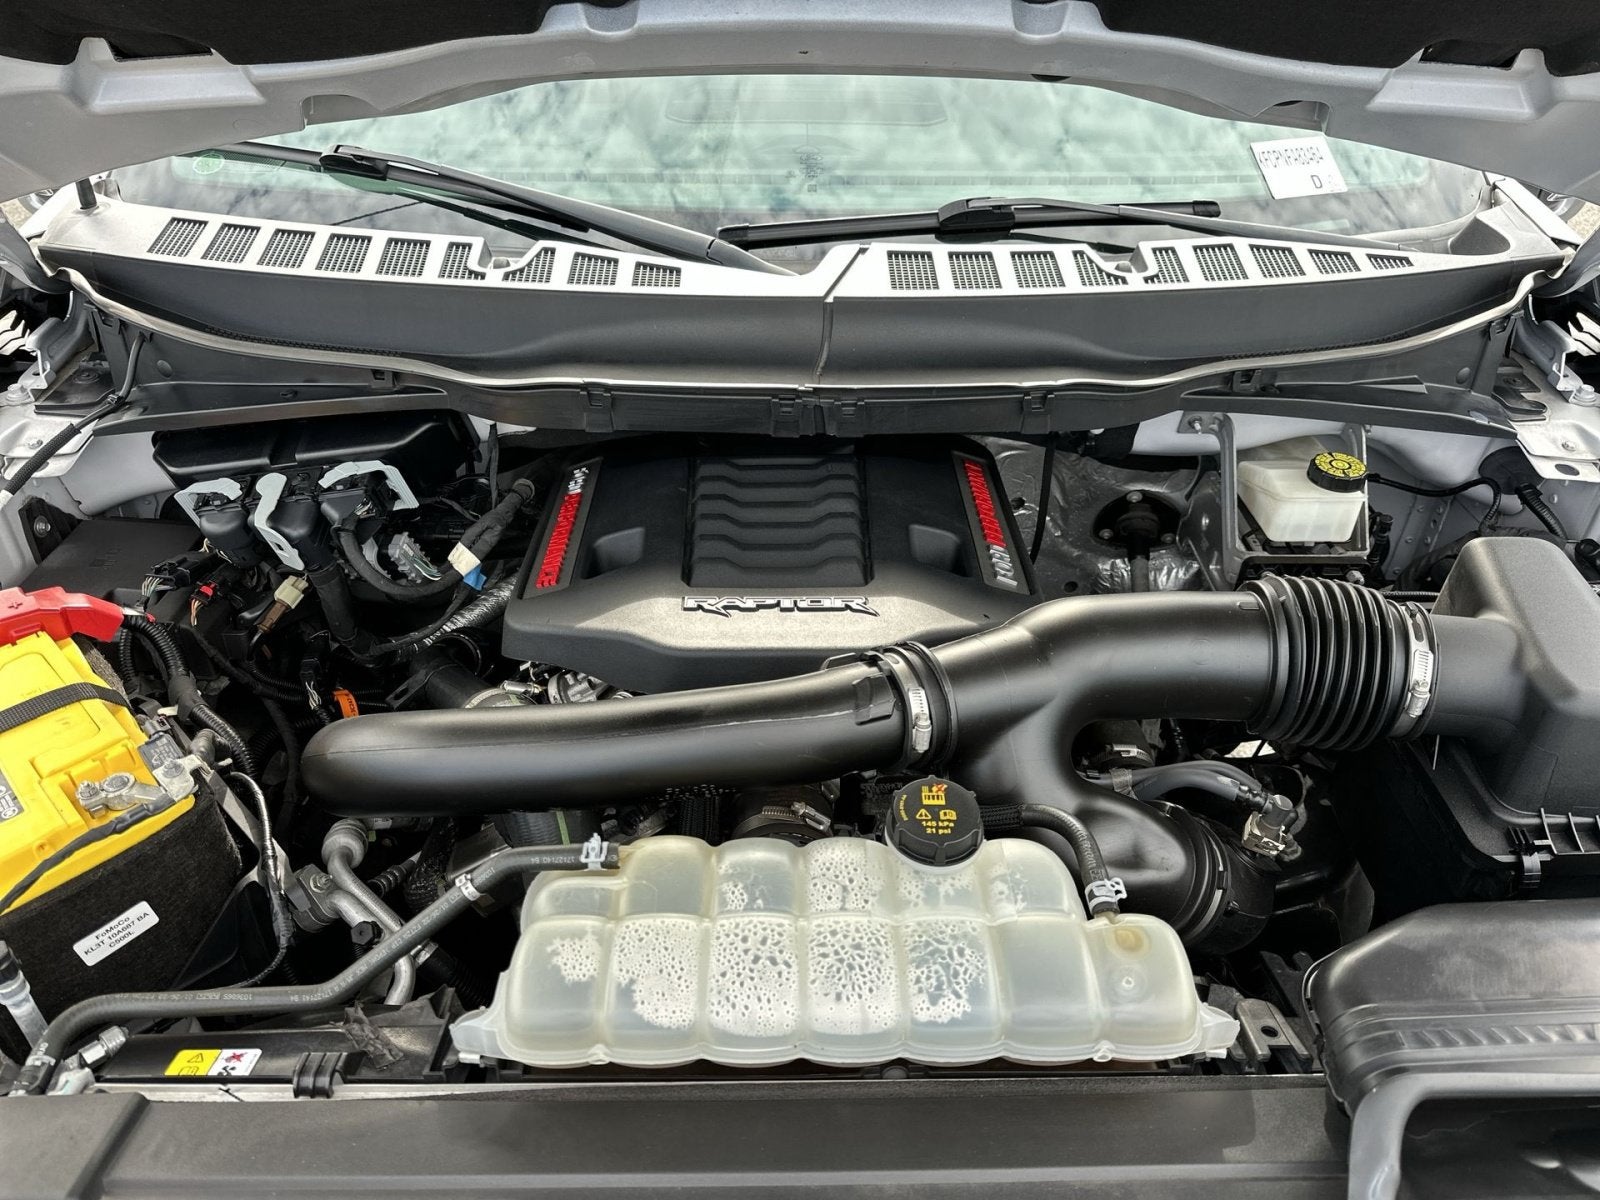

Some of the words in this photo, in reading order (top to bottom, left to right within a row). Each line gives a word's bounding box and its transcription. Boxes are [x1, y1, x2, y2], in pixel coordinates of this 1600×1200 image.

[1310, 174, 1323, 189] D
[681, 596, 881, 618] RAPTOR
[95, 916, 130, 940] FoMoCo
[84, 939, 106, 956] KL3T
